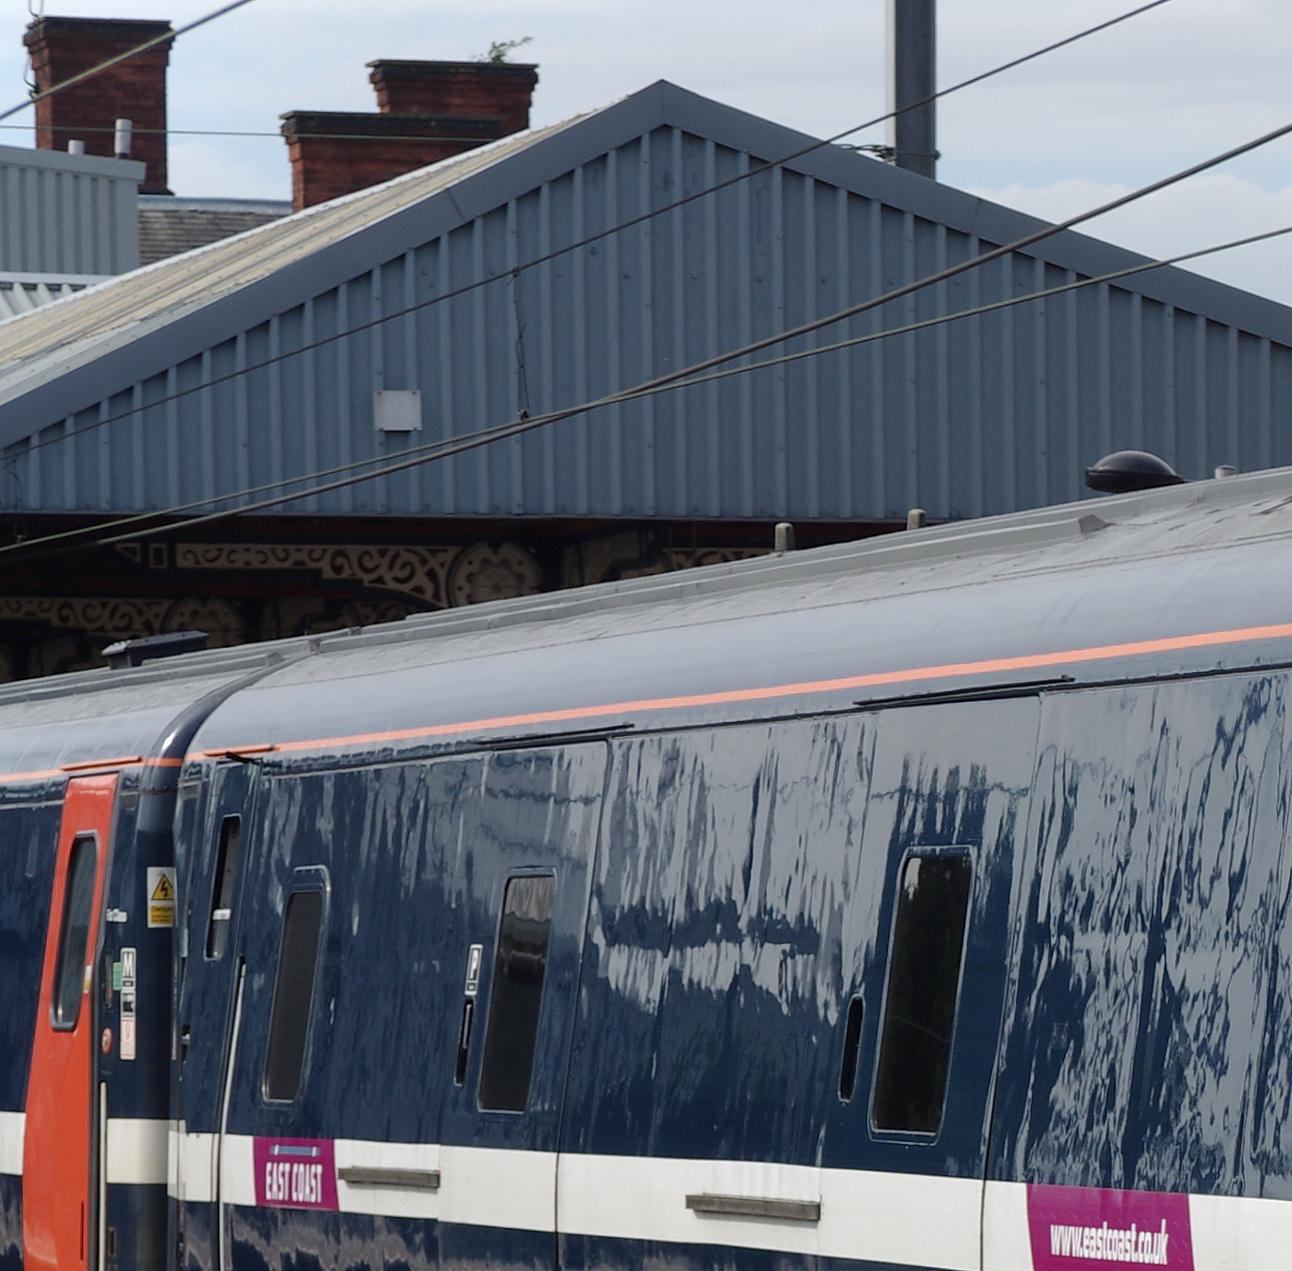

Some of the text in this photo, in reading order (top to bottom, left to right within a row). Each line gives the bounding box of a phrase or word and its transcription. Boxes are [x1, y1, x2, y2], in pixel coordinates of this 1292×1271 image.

[123, 951, 134, 978] M
[266, 1161, 323, 1203] EAST COAST
[1050, 1218, 1169, 1265] www.eastcoast.co.uk
